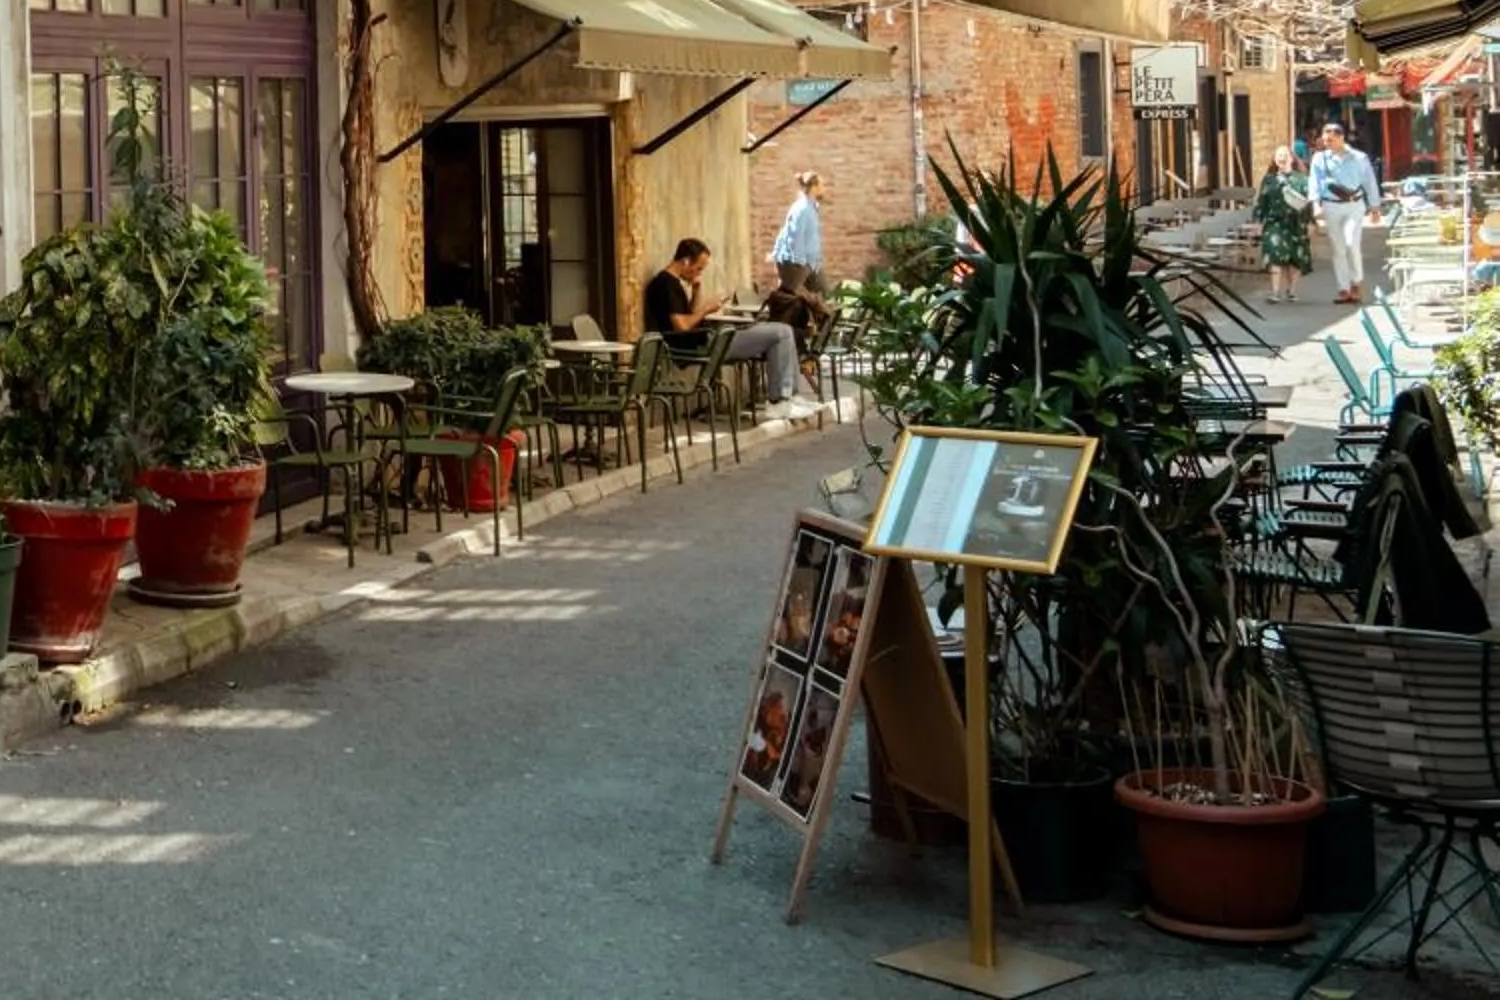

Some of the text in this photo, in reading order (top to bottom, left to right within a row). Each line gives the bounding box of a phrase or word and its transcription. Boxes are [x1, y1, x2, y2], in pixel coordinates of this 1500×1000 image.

[1134, 66, 1152, 80] LE
[1134, 77, 1176, 91] PETIT
[1134, 89, 1176, 102] PERA
[1141, 109, 1190, 119] EXPRESS
